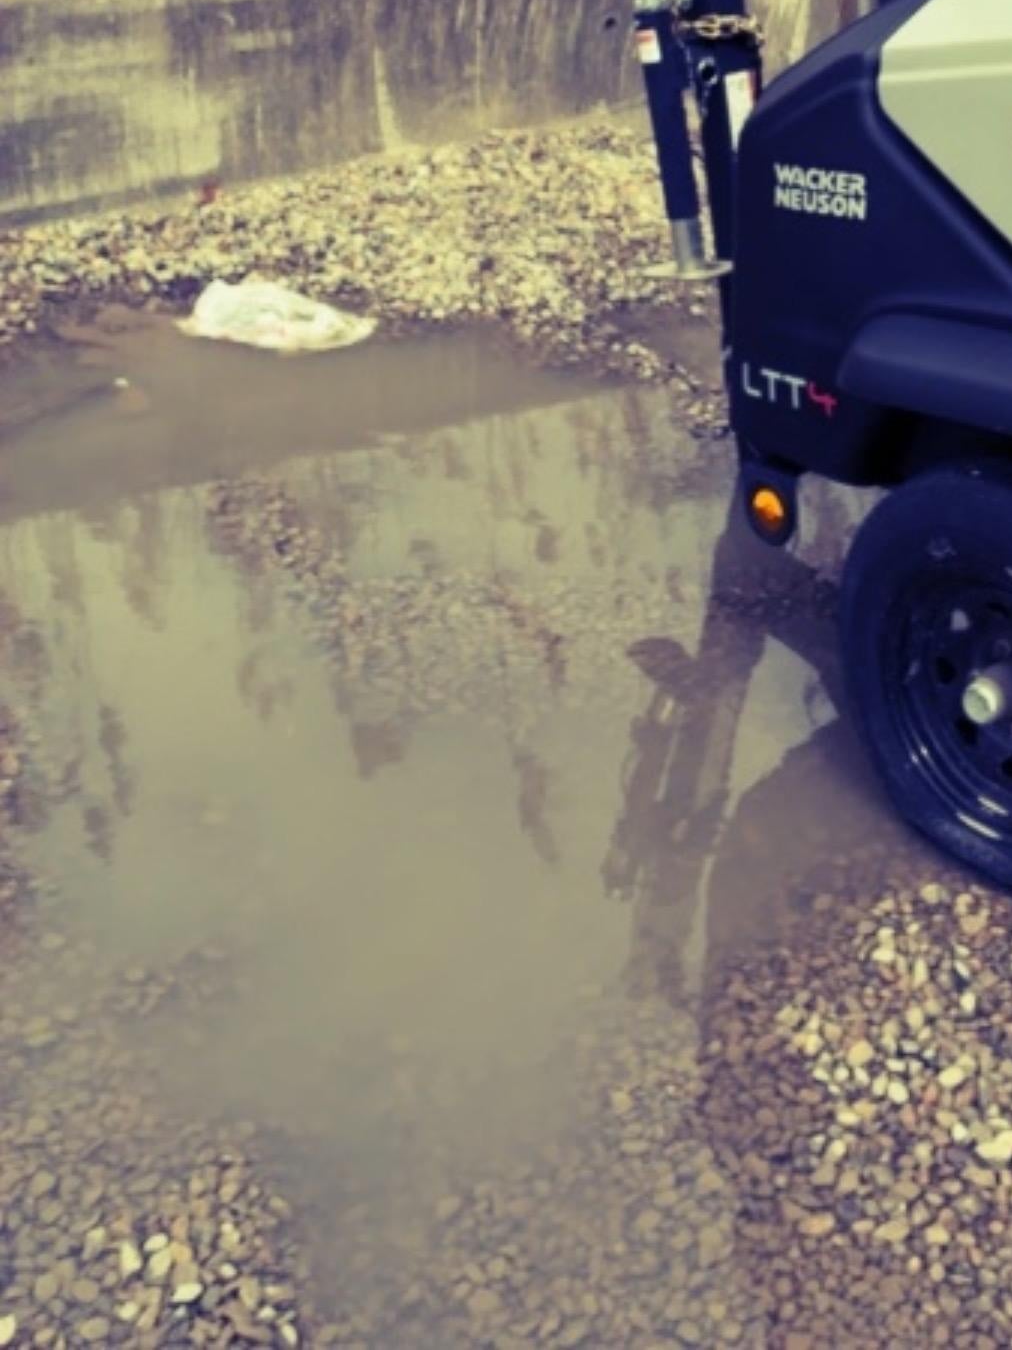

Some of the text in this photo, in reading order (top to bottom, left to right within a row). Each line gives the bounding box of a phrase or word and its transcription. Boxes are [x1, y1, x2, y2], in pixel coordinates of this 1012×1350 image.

[774, 163, 866, 196] WACKER
[774, 187, 866, 220] NEUSON
[742, 362, 838, 418] LTT4
